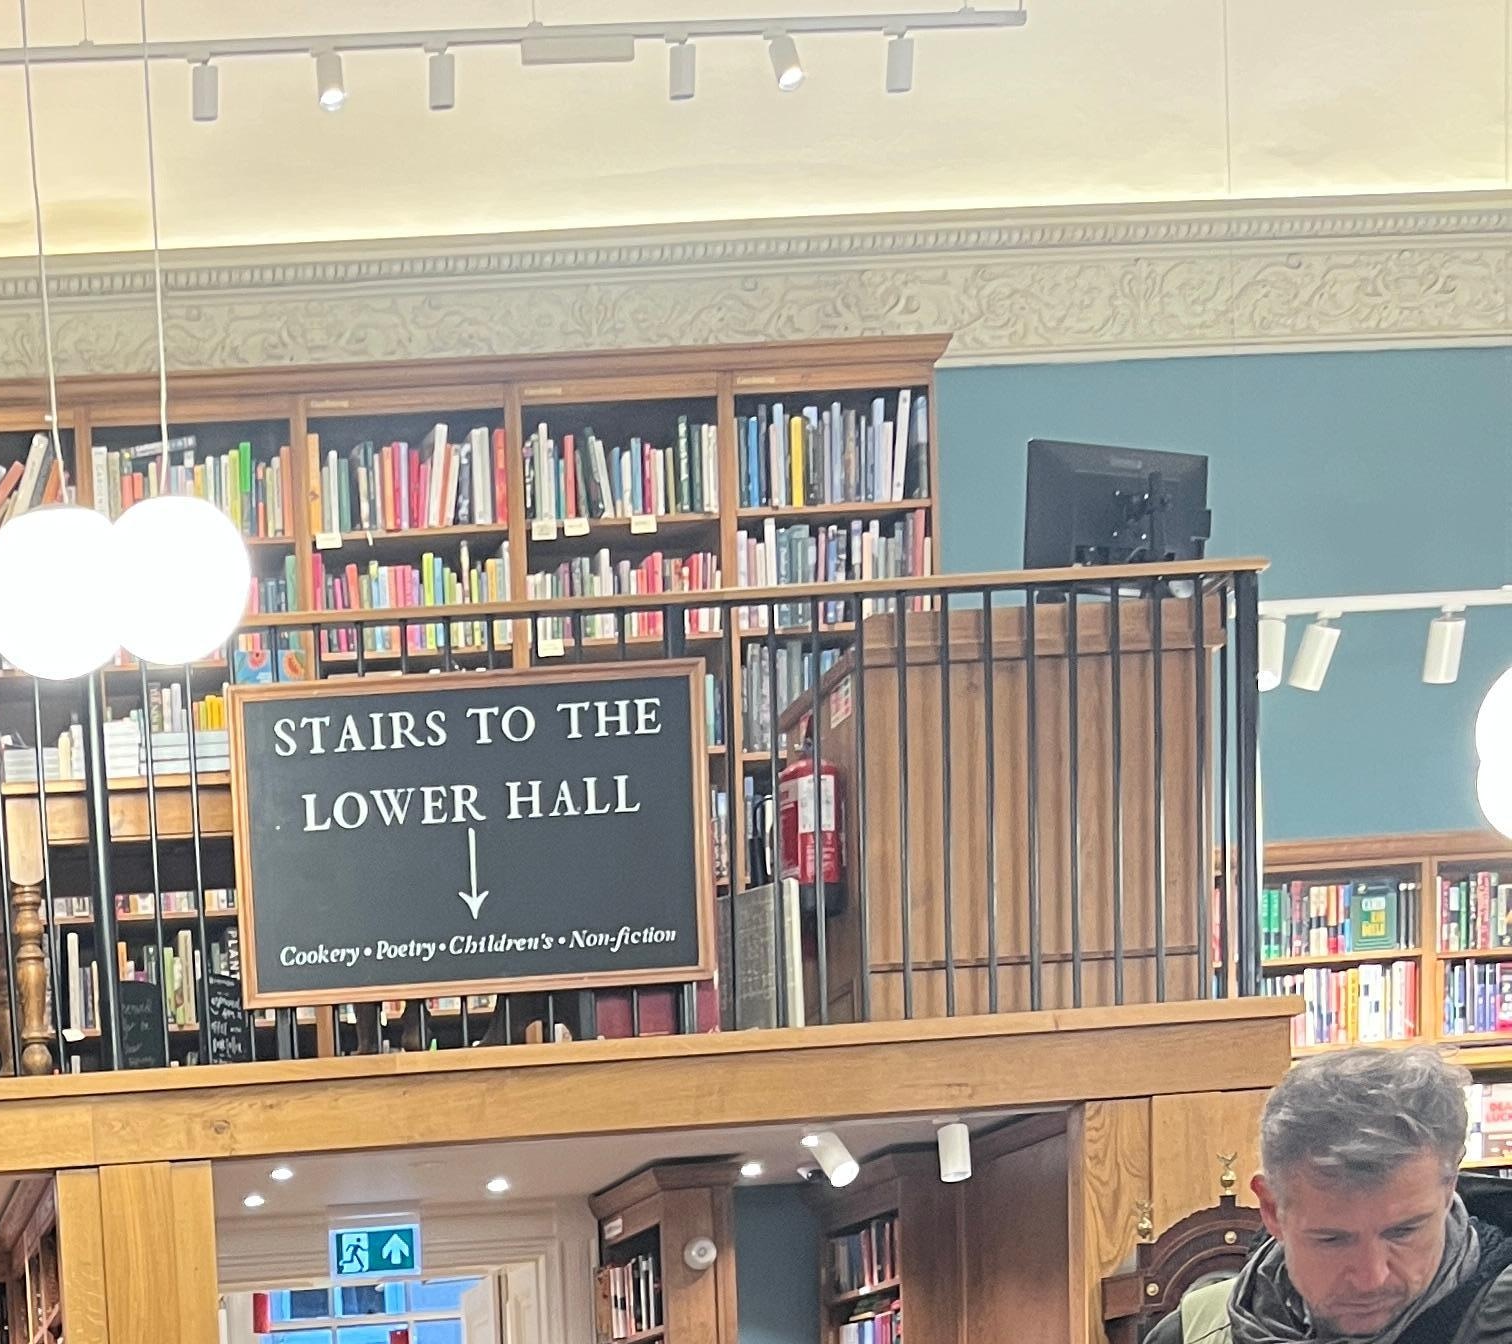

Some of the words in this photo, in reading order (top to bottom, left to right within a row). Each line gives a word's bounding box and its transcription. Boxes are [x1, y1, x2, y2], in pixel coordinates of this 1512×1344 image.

[273, 709, 448, 758] STAIRS
[466, 704, 536, 746] TO
[556, 697, 663, 740] THE
[302, 783, 487, 834] LOWER
[506, 774, 642, 822] HALL
[279, 942, 360, 968] Cookery
[375, 938, 437, 962] Poetry
[448, 931, 554, 956] Children's
[568, 925, 678, 950] Non-fiction
